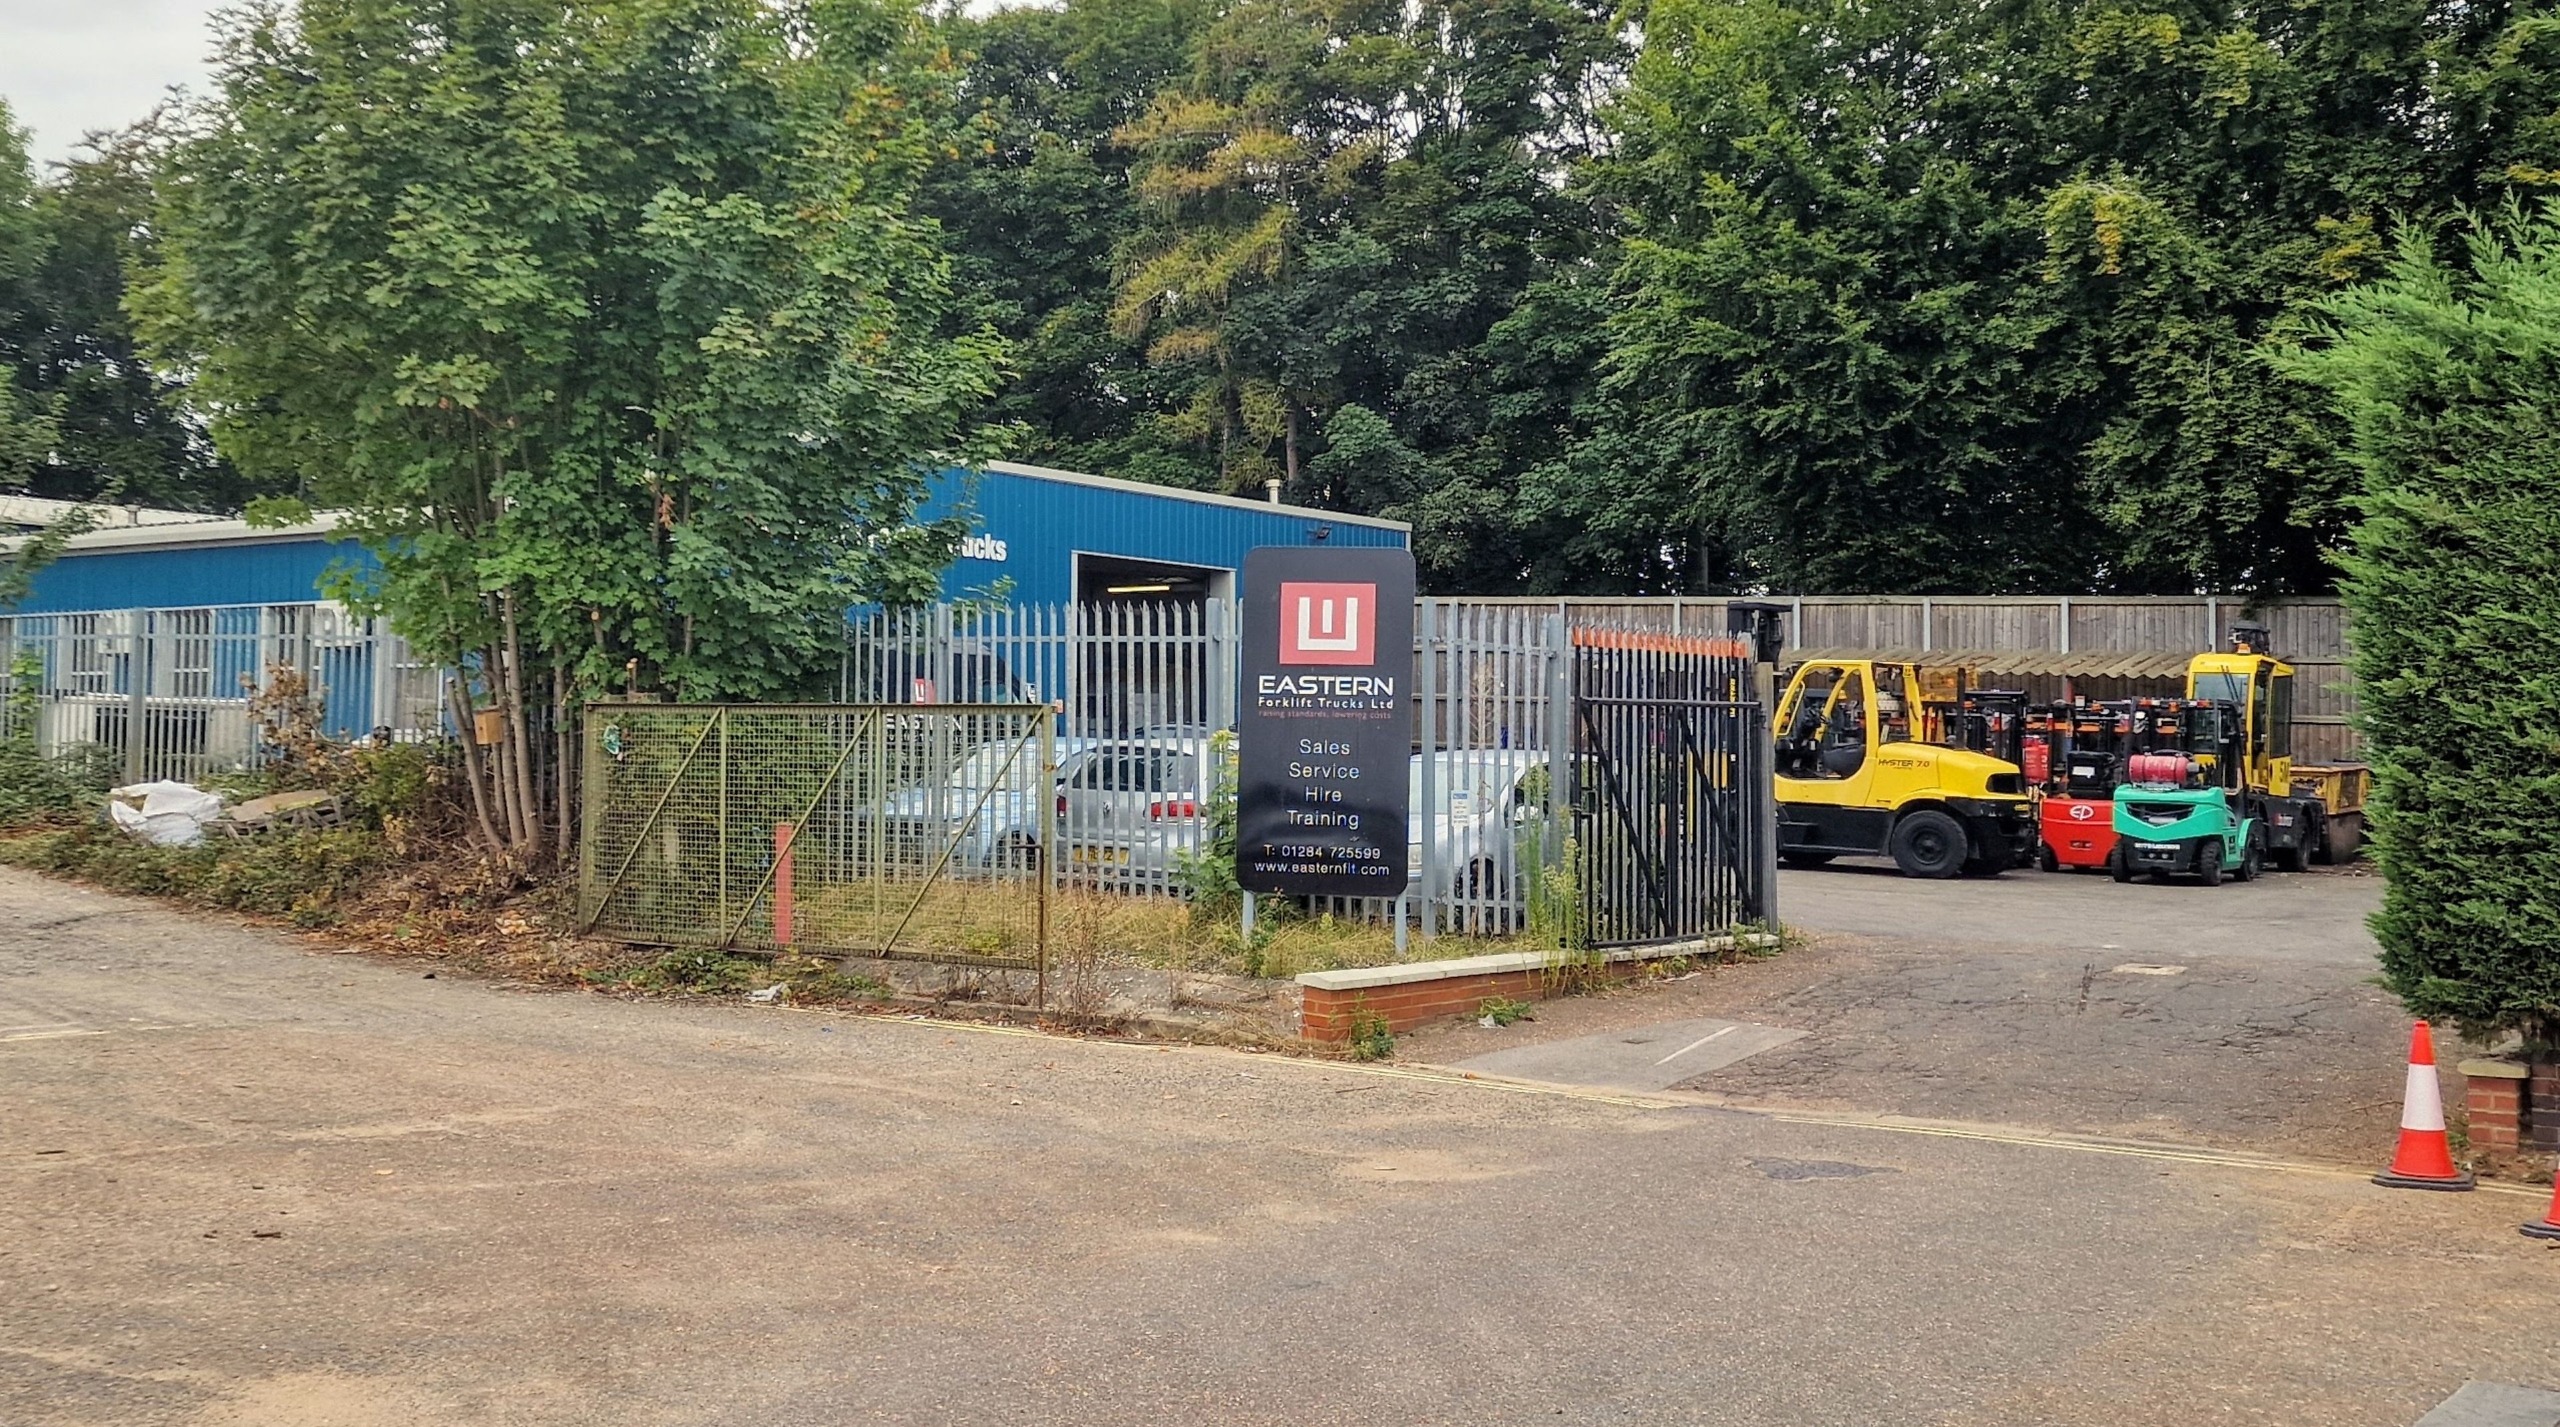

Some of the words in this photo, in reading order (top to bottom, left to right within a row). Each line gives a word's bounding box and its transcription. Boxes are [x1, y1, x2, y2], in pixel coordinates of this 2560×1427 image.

[948, 533, 1008, 562] ucks
[1258, 674, 1394, 696] EASTERN
[1258, 696, 1312, 708] Forklift
[1318, 697, 1364, 709] Trucks
[1371, 699, 1394, 709] Ltd
[1299, 738, 1351, 755] Sales
[1289, 761, 1360, 779] Service
[1305, 786, 1342, 802] Hire
[1287, 809, 1360, 830] Training
[1264, 843, 1276, 857] T:
[1281, 844, 1322, 858] 01284
[1329, 846, 1381, 860] 725599
